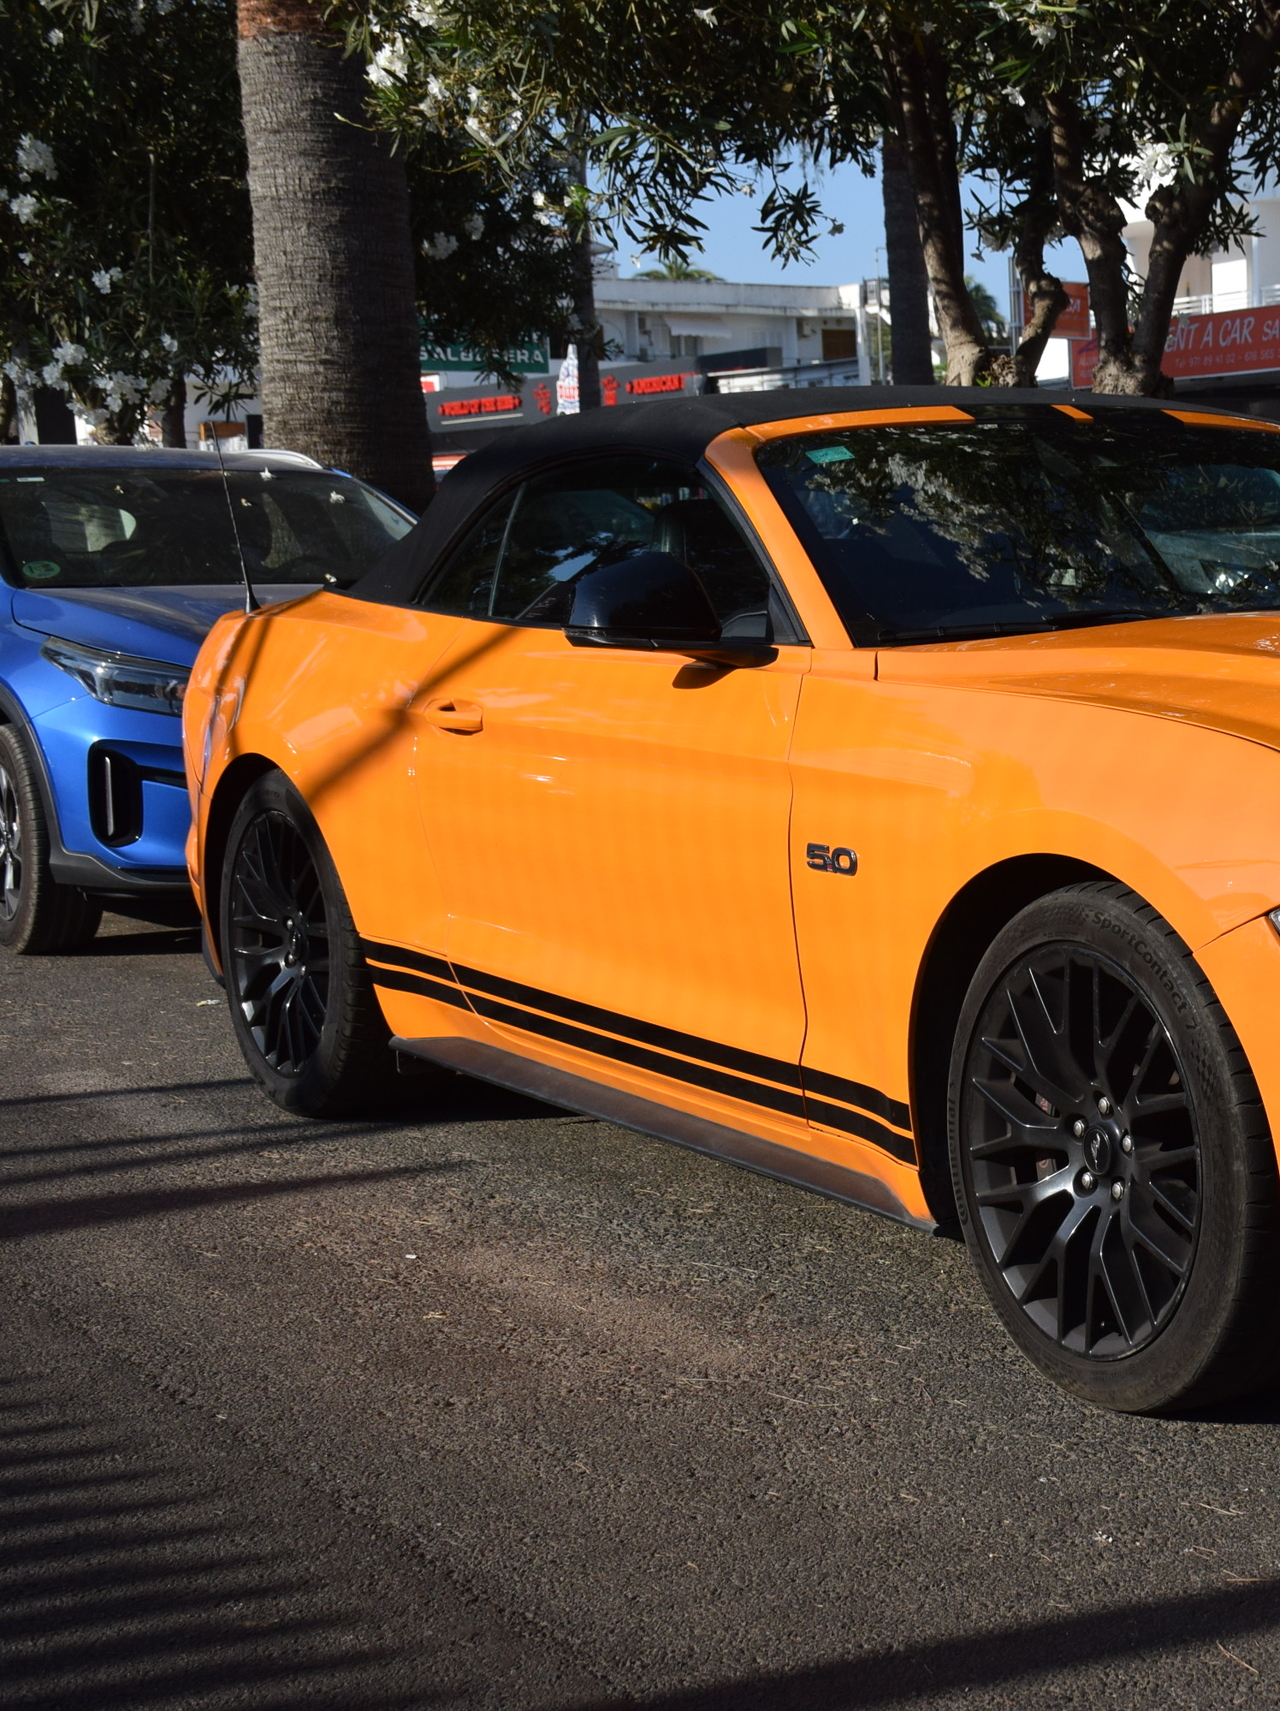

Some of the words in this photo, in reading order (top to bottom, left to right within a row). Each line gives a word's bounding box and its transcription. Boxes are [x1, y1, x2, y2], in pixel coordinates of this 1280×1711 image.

[1164, 322, 1199, 353] ENT
[1200, 321, 1213, 349] A
[1218, 316, 1255, 347] CAR
[1091, 911, 1188, 1014] SportContact
